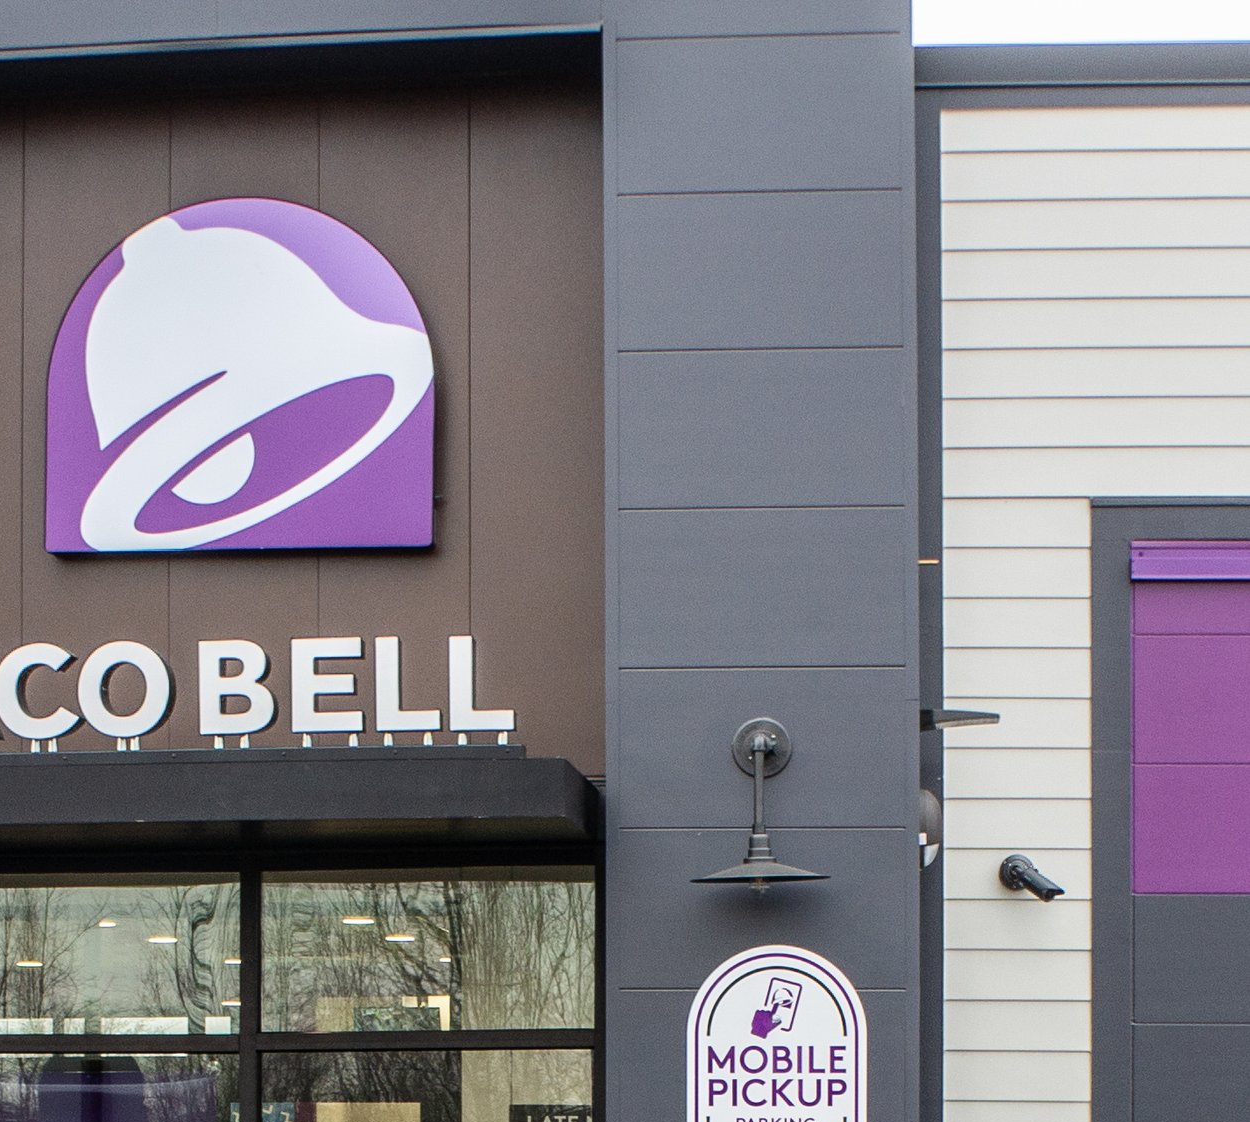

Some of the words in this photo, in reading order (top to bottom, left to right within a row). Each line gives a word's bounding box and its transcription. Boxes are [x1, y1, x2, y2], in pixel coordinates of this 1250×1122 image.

[198, 635, 515, 735] BELL
[707, 1045, 847, 1074] MOBILE
[708, 1078, 847, 1107] PICKUP
